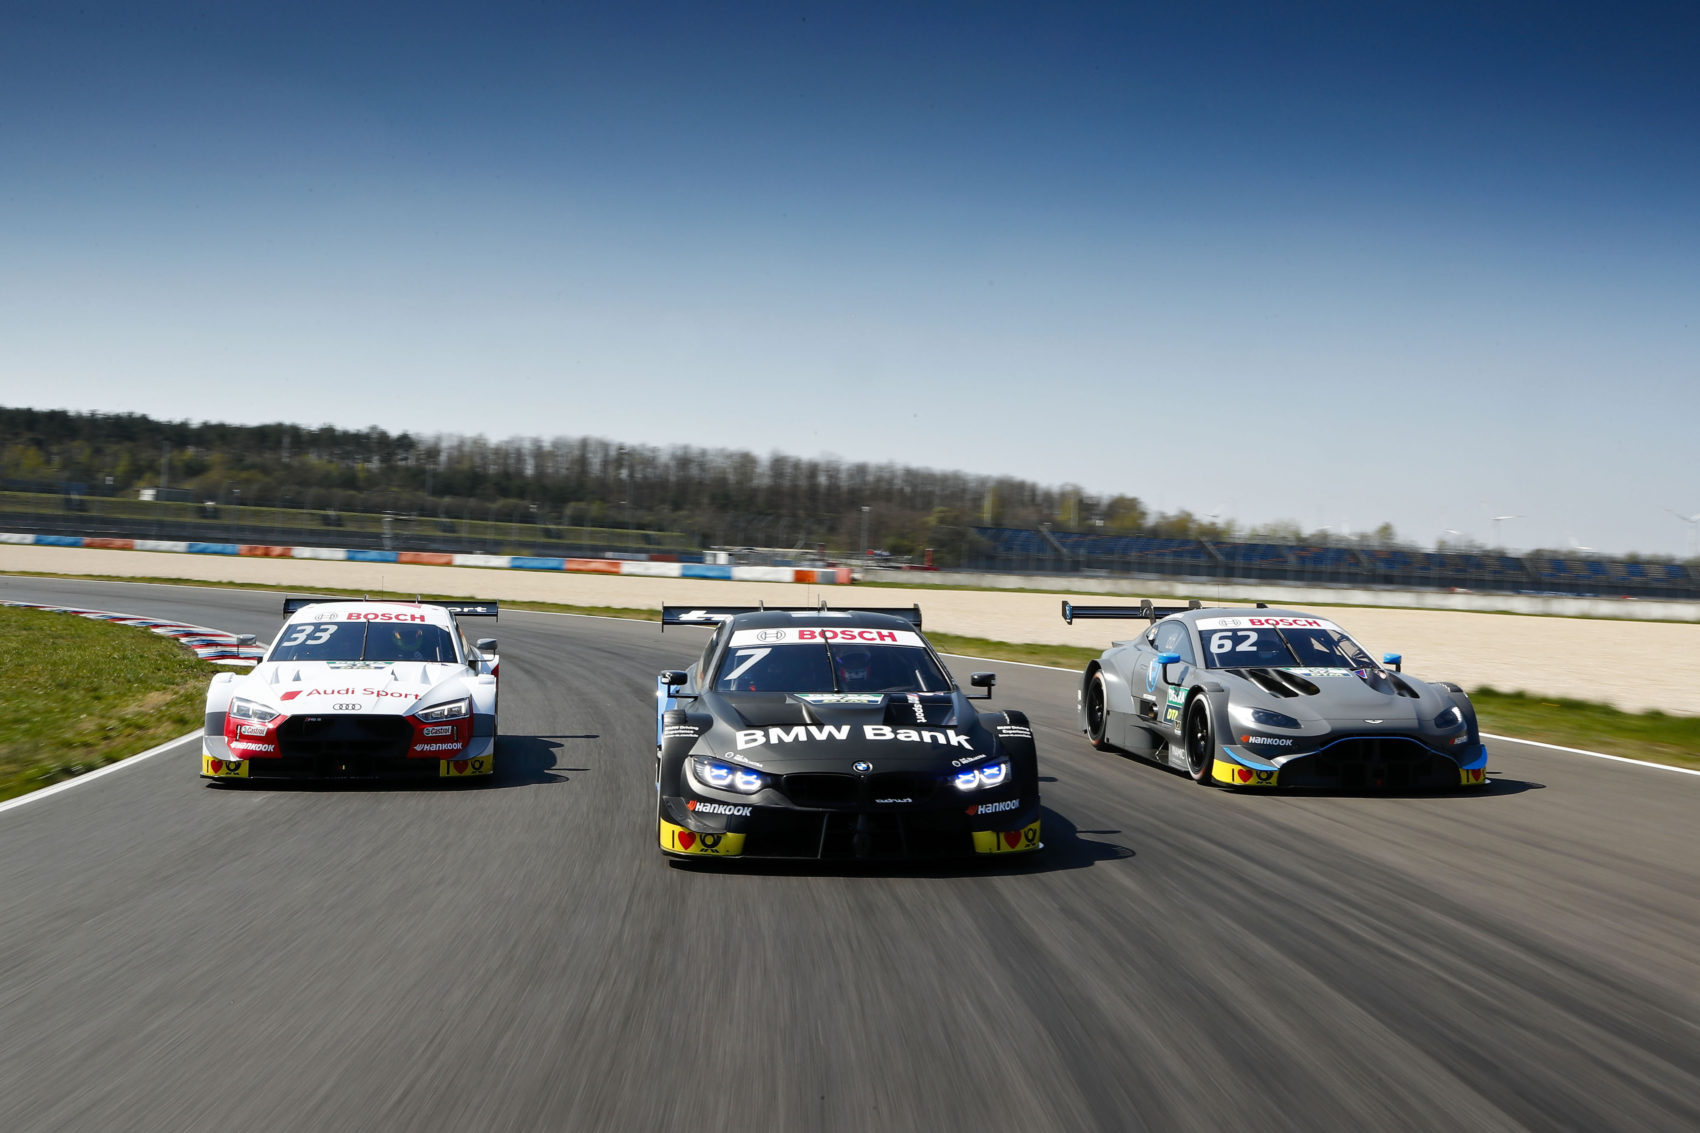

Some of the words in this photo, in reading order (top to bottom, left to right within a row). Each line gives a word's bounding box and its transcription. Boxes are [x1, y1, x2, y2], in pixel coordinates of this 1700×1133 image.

[346, 612, 426, 622] BOSCH
[1248, 618, 1322, 628] BOSCH
[281, 624, 338, 647] 33
[798, 629, 898, 643] BOSCH
[1209, 630, 1259, 654] 62
[724, 647, 773, 681] 7
[306, 688, 356, 697] Audi
[362, 687, 421, 701] Sport
[736, 725, 851, 751] BMW
[863, 725, 975, 751] Bank
